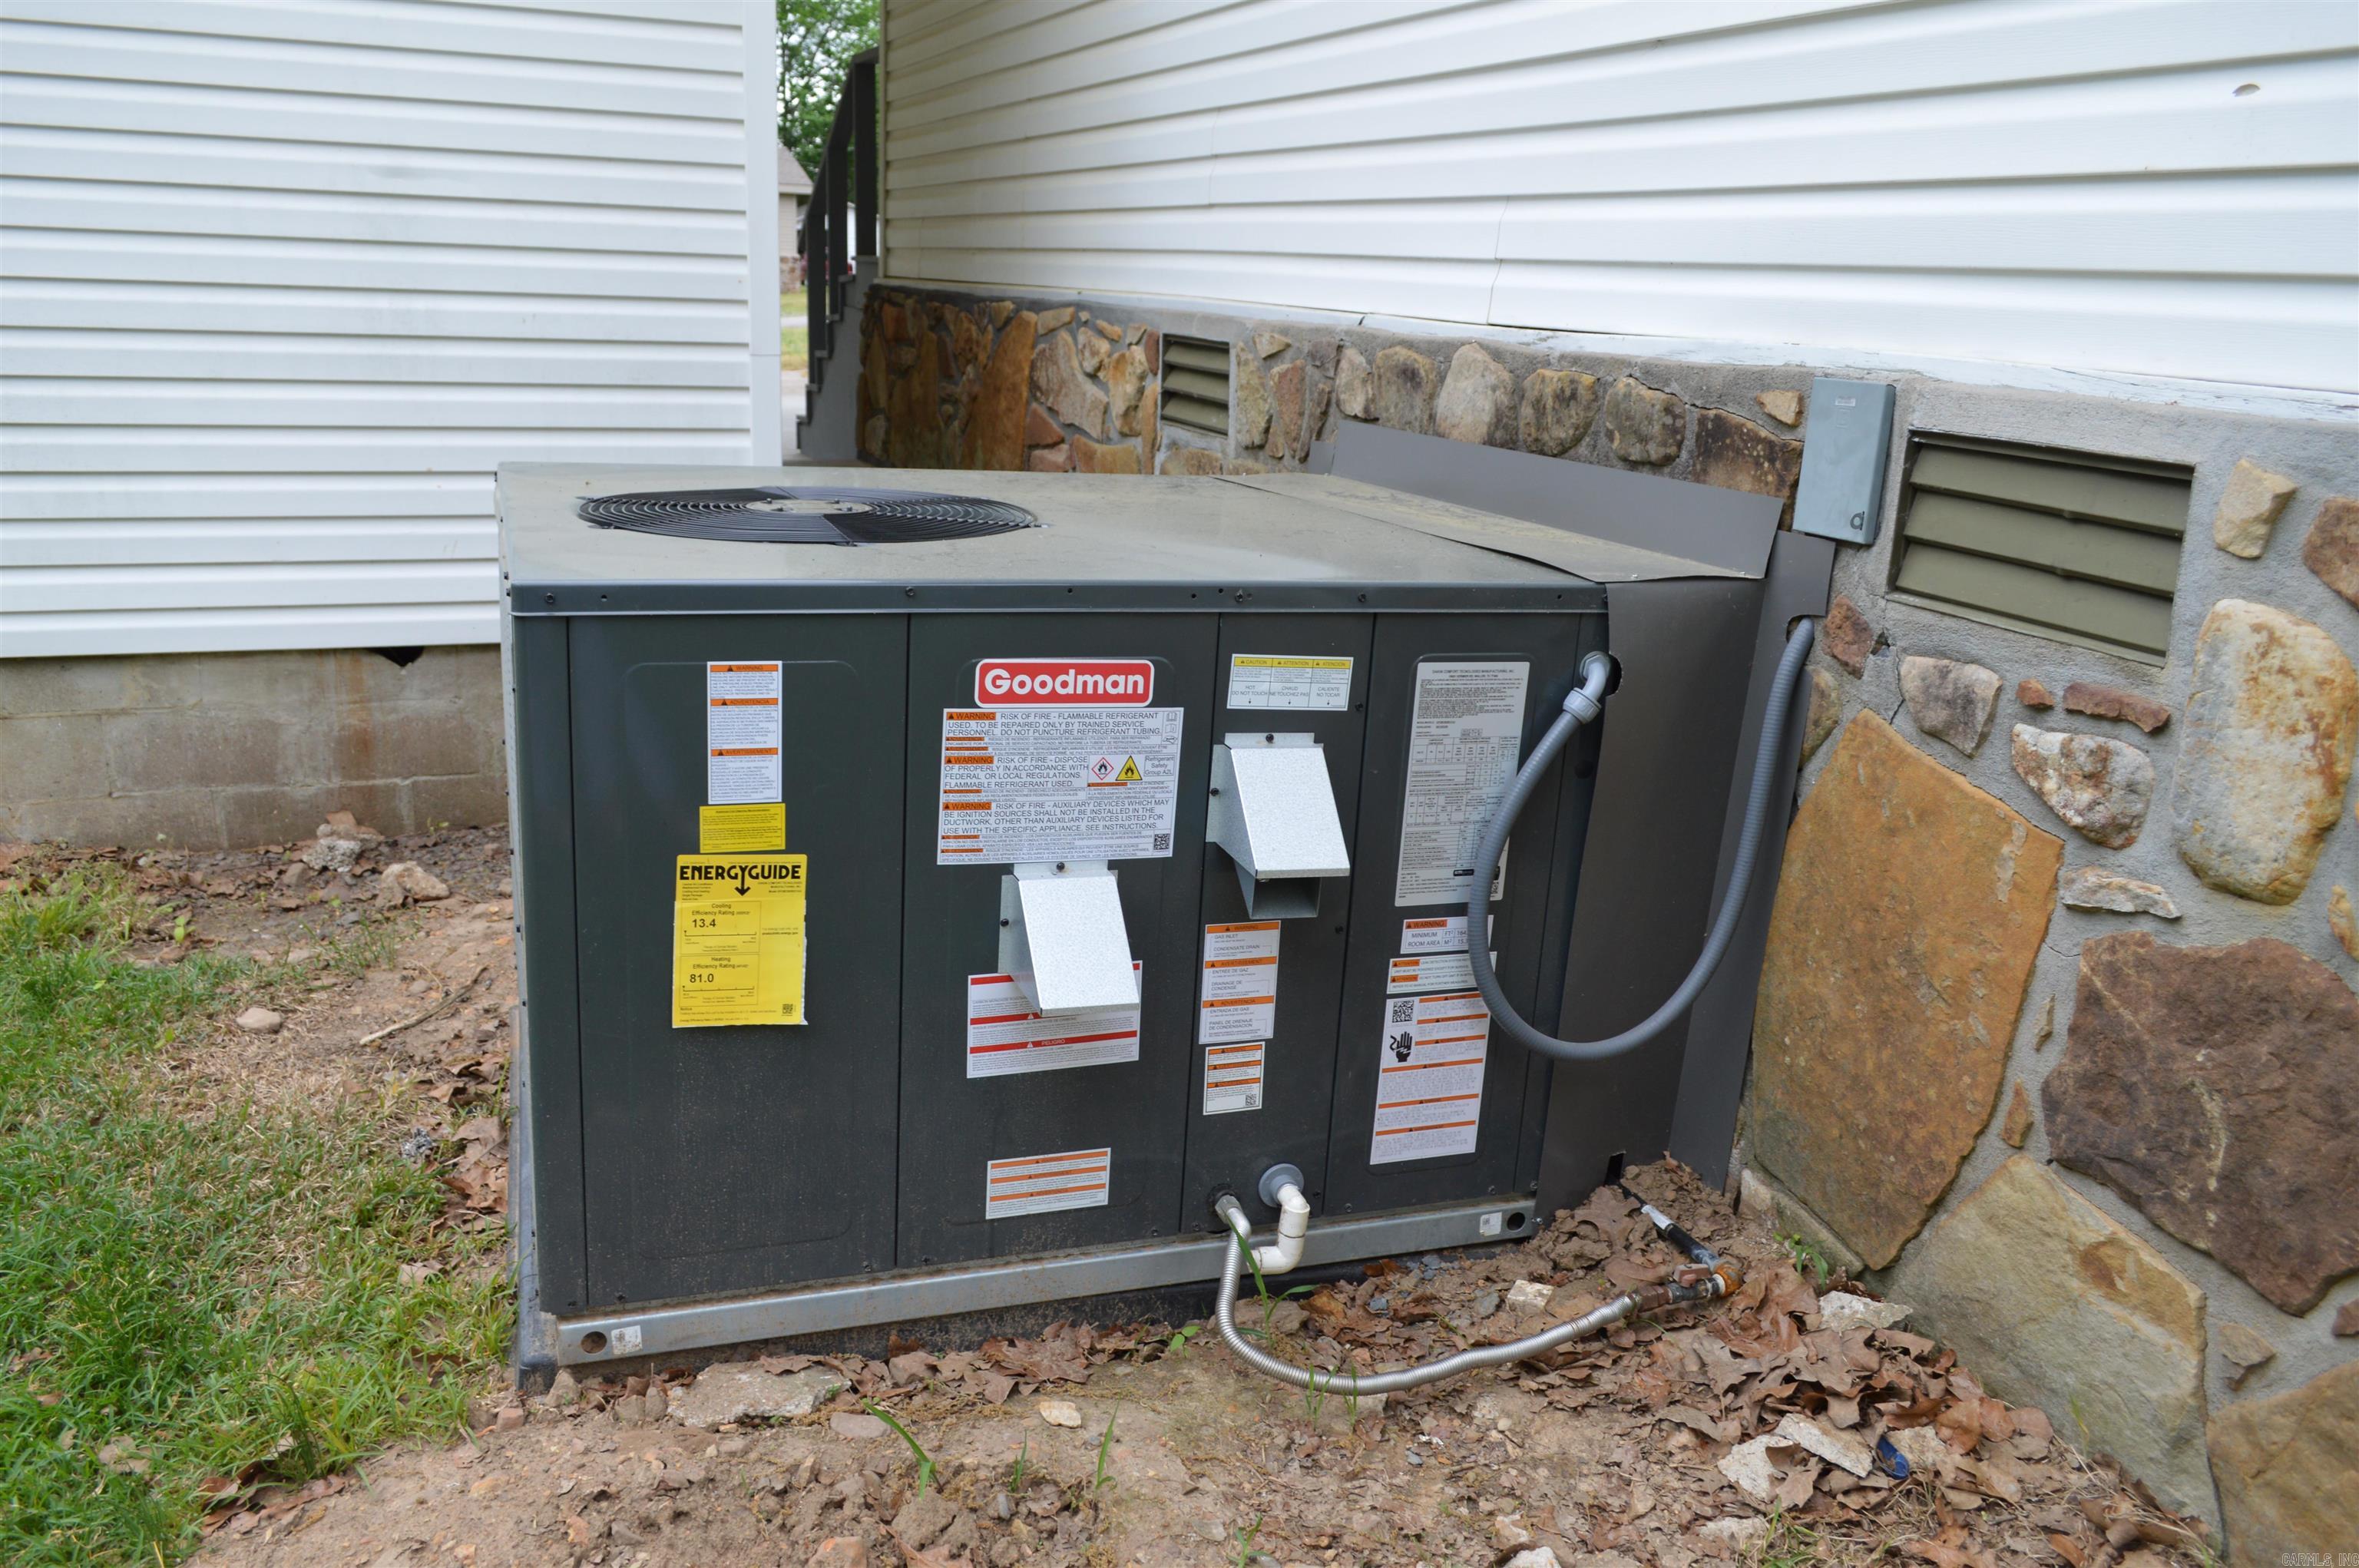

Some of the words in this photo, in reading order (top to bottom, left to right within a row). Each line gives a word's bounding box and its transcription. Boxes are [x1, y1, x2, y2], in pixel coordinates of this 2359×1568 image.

[984, 668, 1144, 695] Goodman
[680, 865, 801, 880] ENERGYGUIDE
[692, 918, 716, 928] 13.4
[690, 974, 714, 983] 81.0
